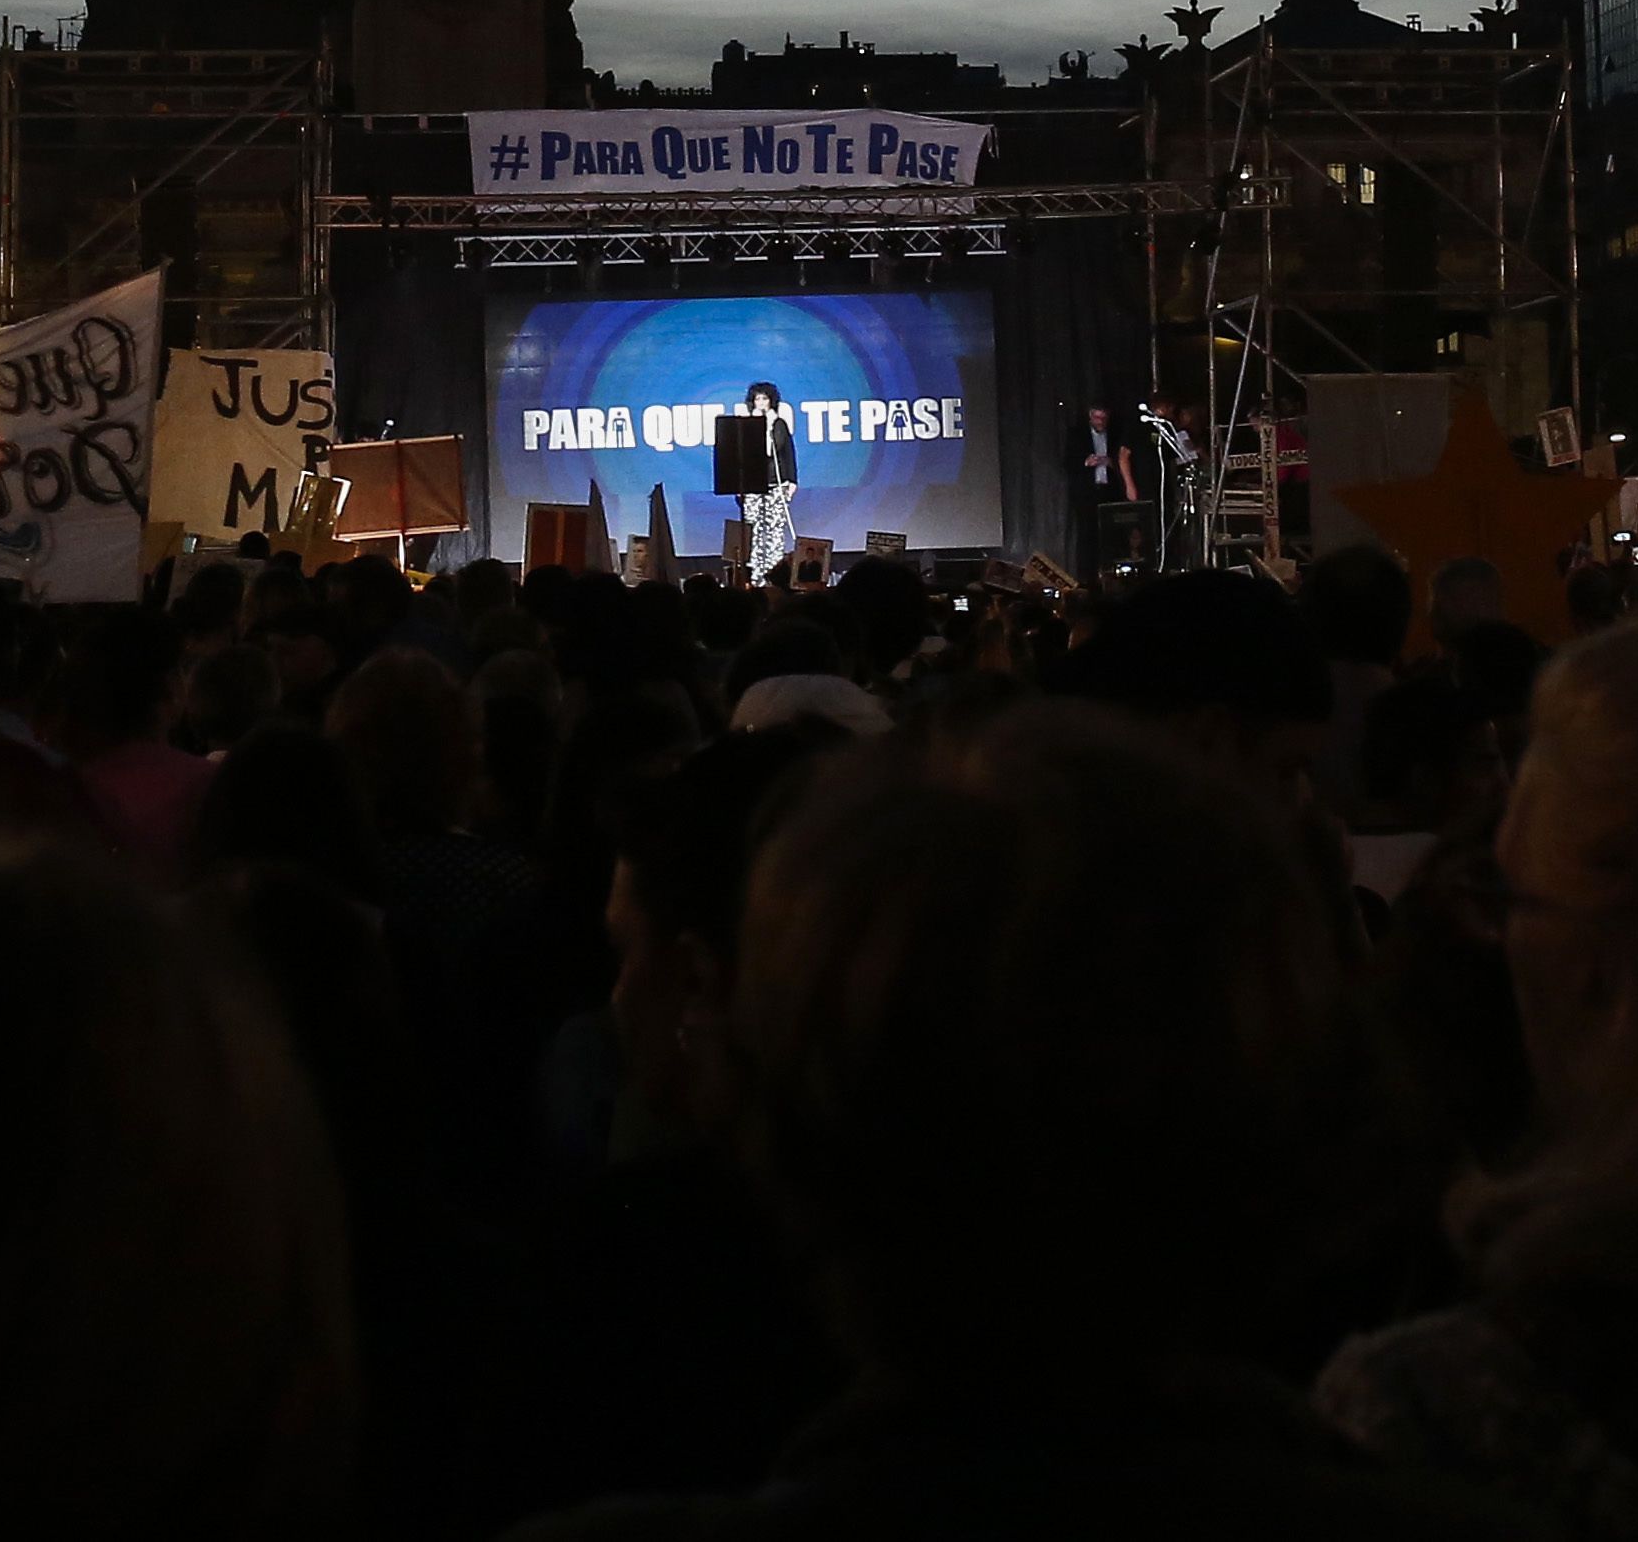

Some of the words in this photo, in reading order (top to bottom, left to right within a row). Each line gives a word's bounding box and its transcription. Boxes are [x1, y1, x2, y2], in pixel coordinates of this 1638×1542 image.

[523, 406, 637, 451] PARA
[800, 400, 852, 443] TE
[859, 397, 964, 442] PASE
